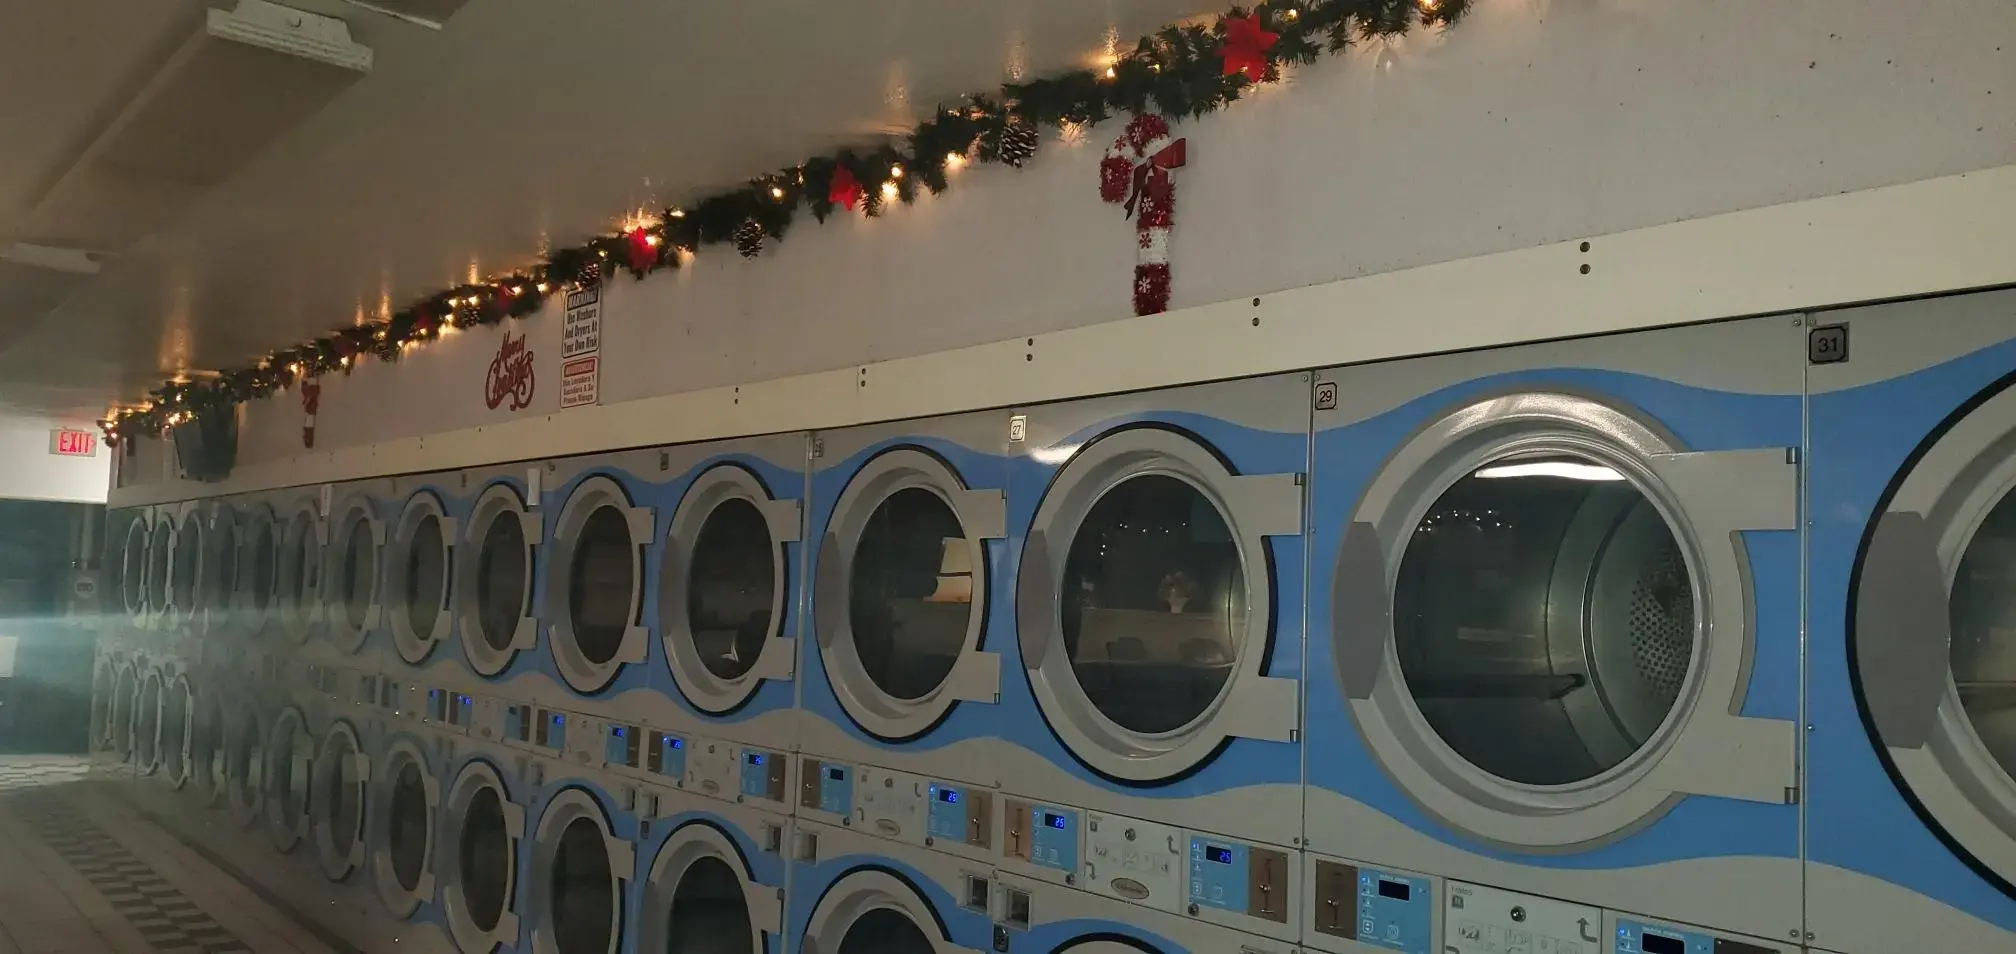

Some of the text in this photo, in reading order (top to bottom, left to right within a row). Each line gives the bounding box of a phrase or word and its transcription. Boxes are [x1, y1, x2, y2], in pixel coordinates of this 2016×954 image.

[567, 308, 597, 325] Use Washers
[565, 320, 598, 340] And Dryers At
[563, 334, 598, 354] Your Own Risk
[1818, 337, 1838, 353] 31
[1319, 390, 1333, 403] 29
[1012, 425, 1021, 435] 27
[59, 431, 92, 454] EXIT
[948, 792, 957, 802] 25
[1055, 816, 1064, 828] 25
[1219, 851, 1231, 862] 25
